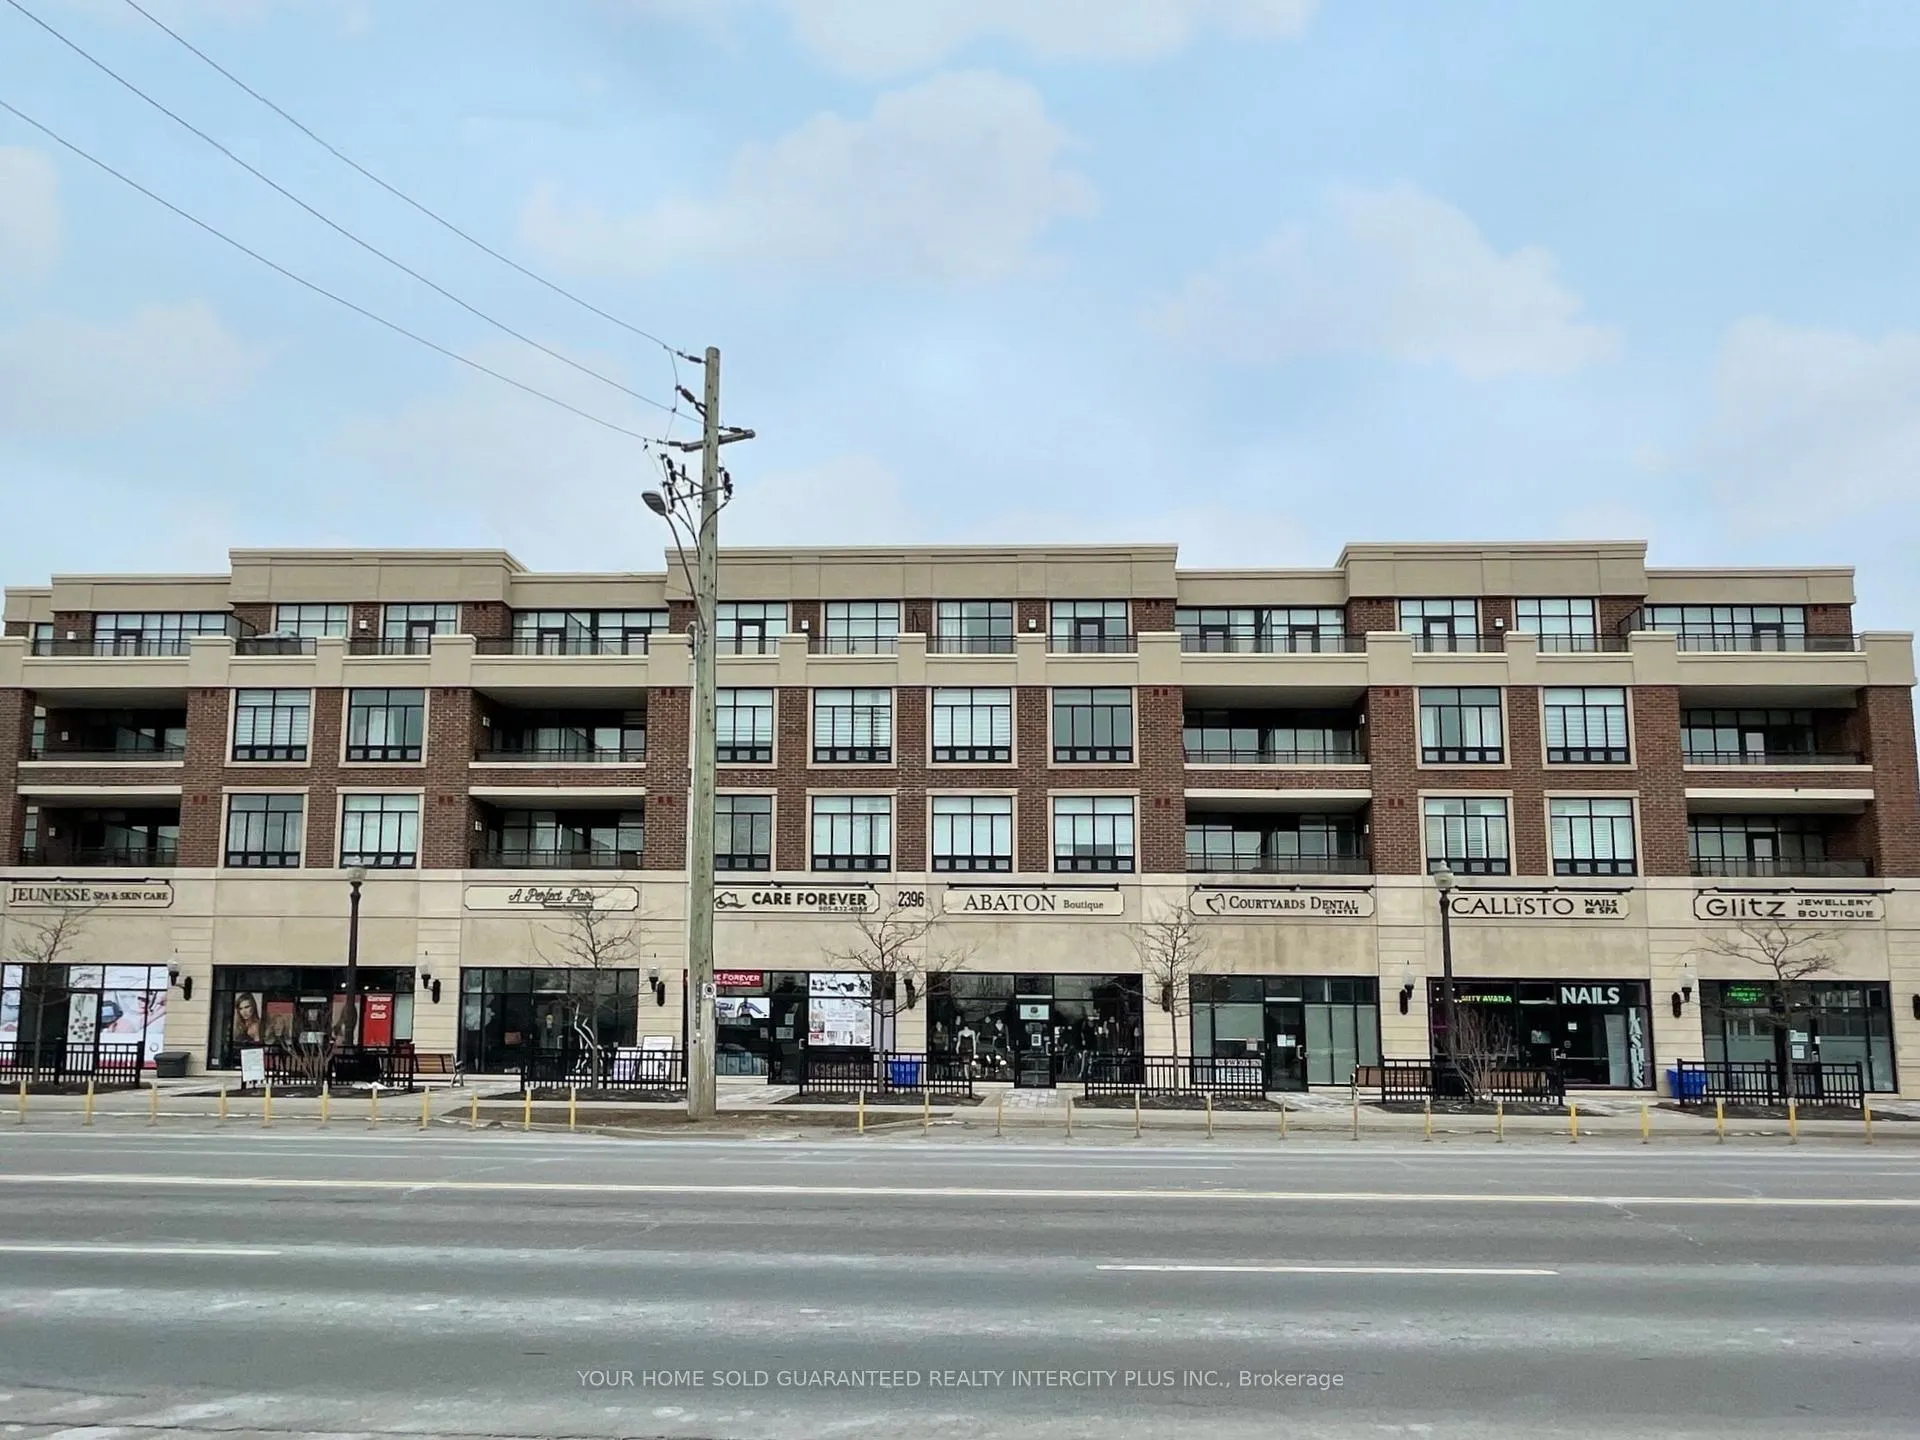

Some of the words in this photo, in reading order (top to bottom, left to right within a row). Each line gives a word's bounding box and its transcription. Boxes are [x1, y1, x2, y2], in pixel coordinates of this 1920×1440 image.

[9, 888, 90, 903] JEUNESSE
[93, 892, 110, 900] SPA
[120, 892, 142, 901] SKIN
[143, 892, 168, 901] CARE
[509, 888, 522, 903] A
[752, 892, 791, 905] CARE
[797, 892, 867, 905] FOREVER
[898, 891, 924, 907] 2396
[963, 894, 1056, 911] ABATON
[1063, 900, 1104, 911] Boutique
[1229, 896, 1305, 909] COURTYARDS
[1310, 896, 1359, 910] DENTAL
[1584, 899, 1617, 907] NAILS
[1599, 906, 1619, 914] SPA
[1706, 898, 1786, 917] Glitz
[1798, 910, 1874, 918] BOUTIQUE
[722, 973, 760, 982] FOREVER
[1561, 987, 1619, 1005] NAILS
